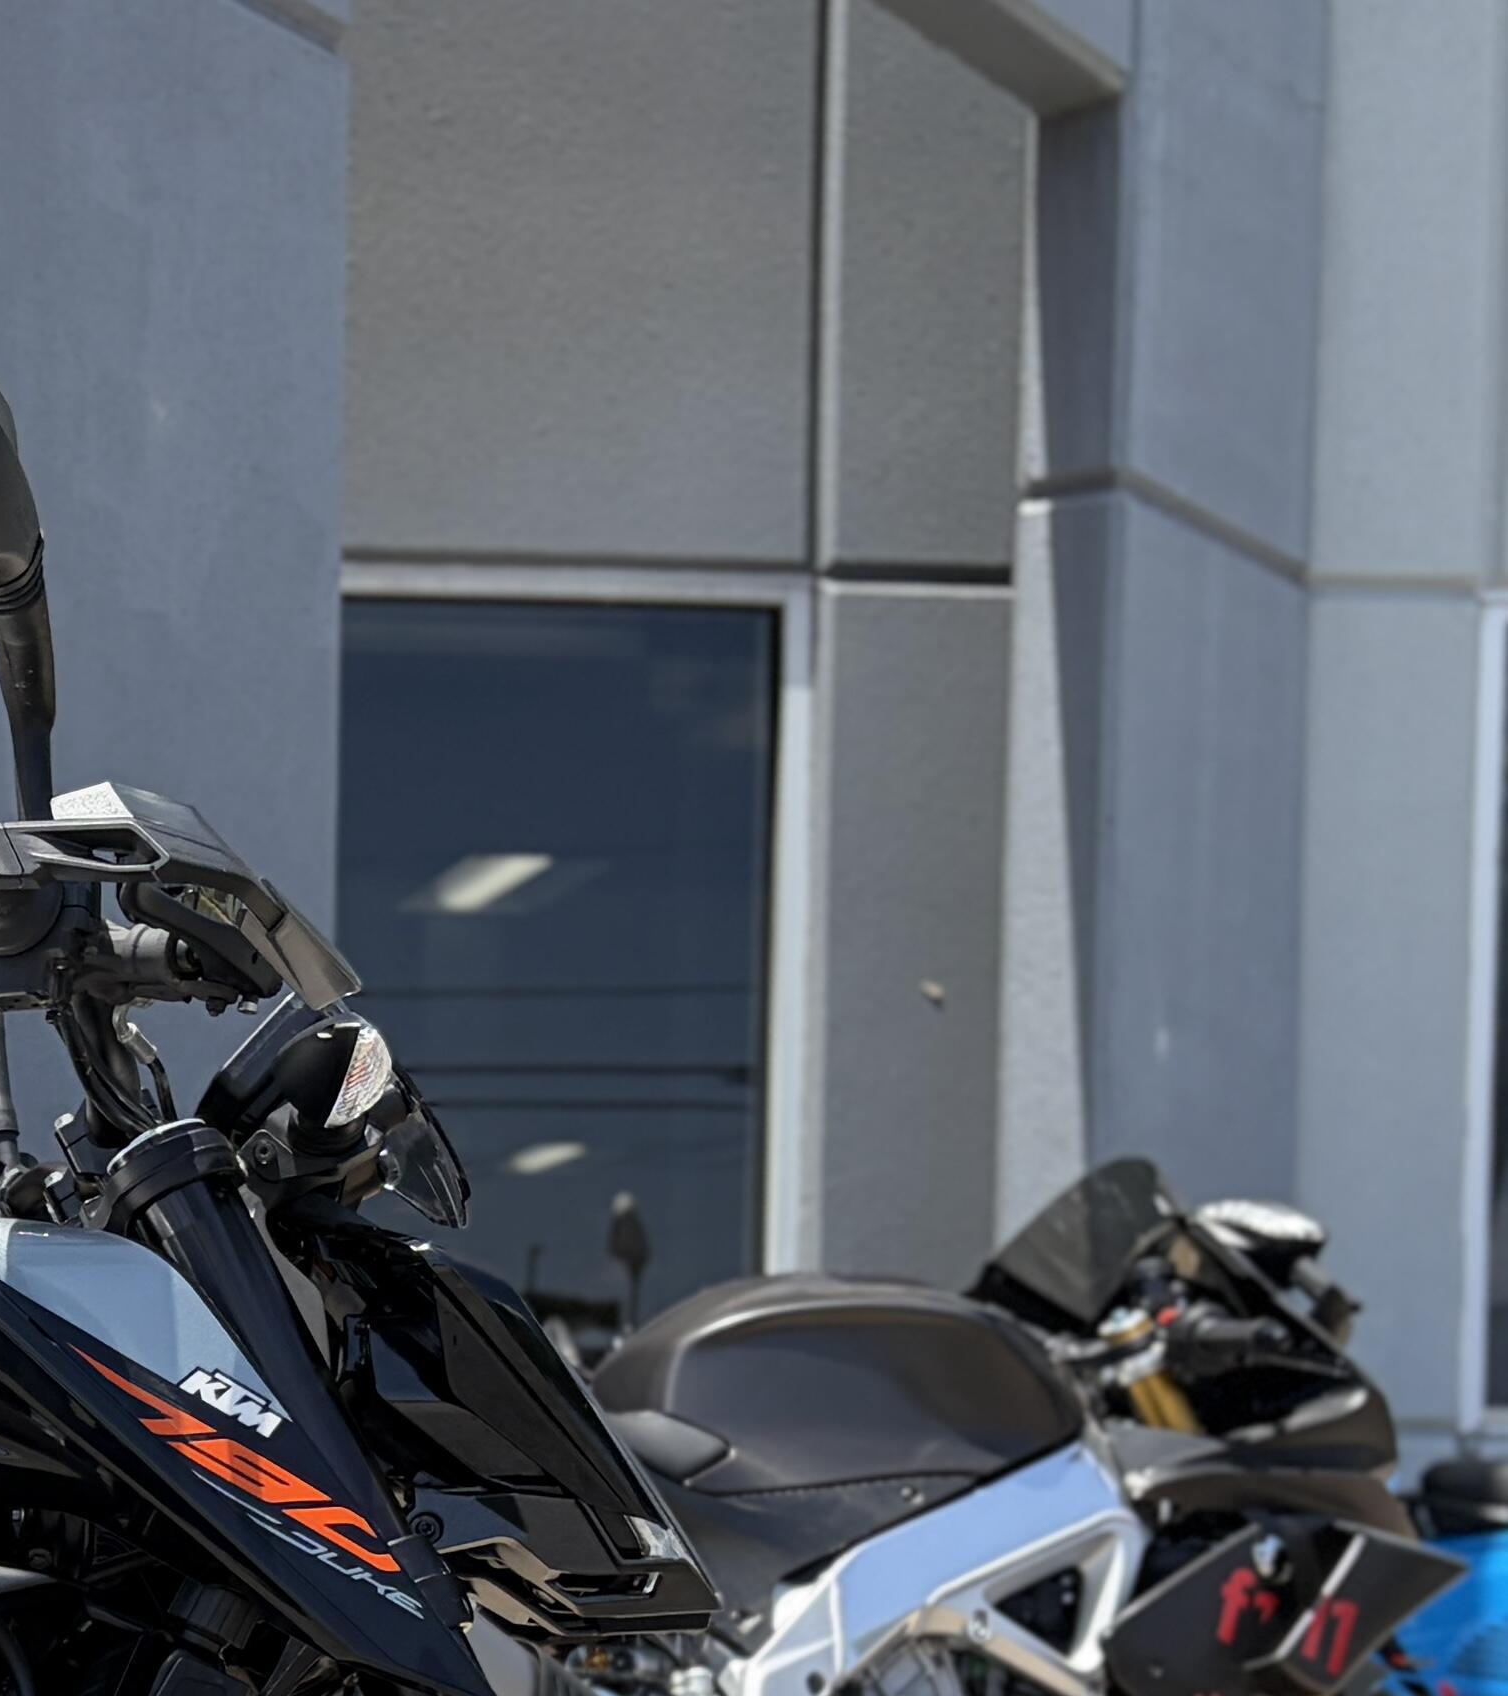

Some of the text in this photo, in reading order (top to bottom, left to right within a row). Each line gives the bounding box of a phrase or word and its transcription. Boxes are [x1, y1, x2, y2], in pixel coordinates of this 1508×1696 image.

[67, 1342, 401, 1572] 790
[178, 1369, 283, 1438] KTM
[247, 1512, 425, 1619] DUKE
